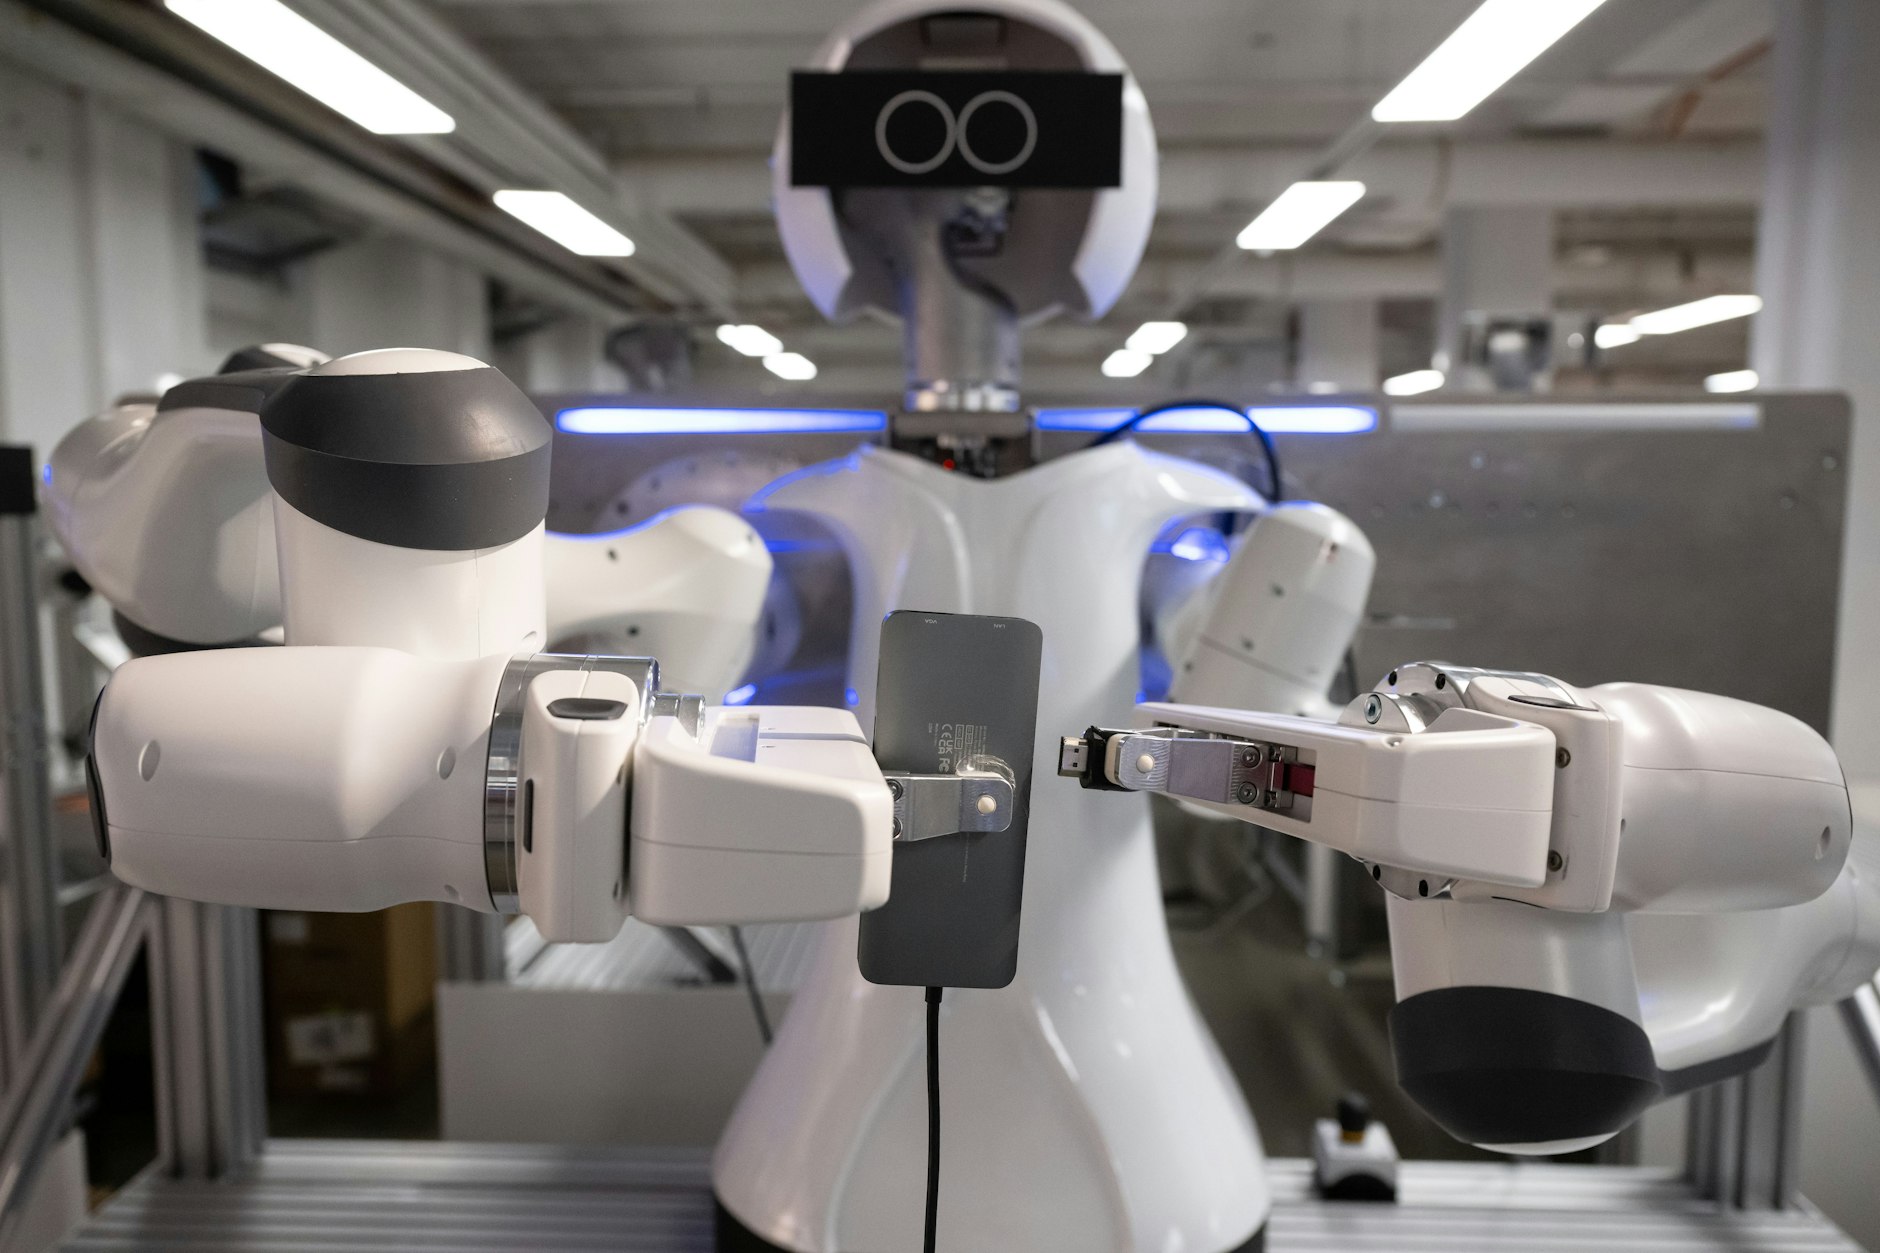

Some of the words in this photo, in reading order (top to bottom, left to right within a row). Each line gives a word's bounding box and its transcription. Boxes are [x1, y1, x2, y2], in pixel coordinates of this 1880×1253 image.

[941, 723, 953, 738] CE
[938, 739, 946, 755] CA
[945, 740, 953, 754] UK
